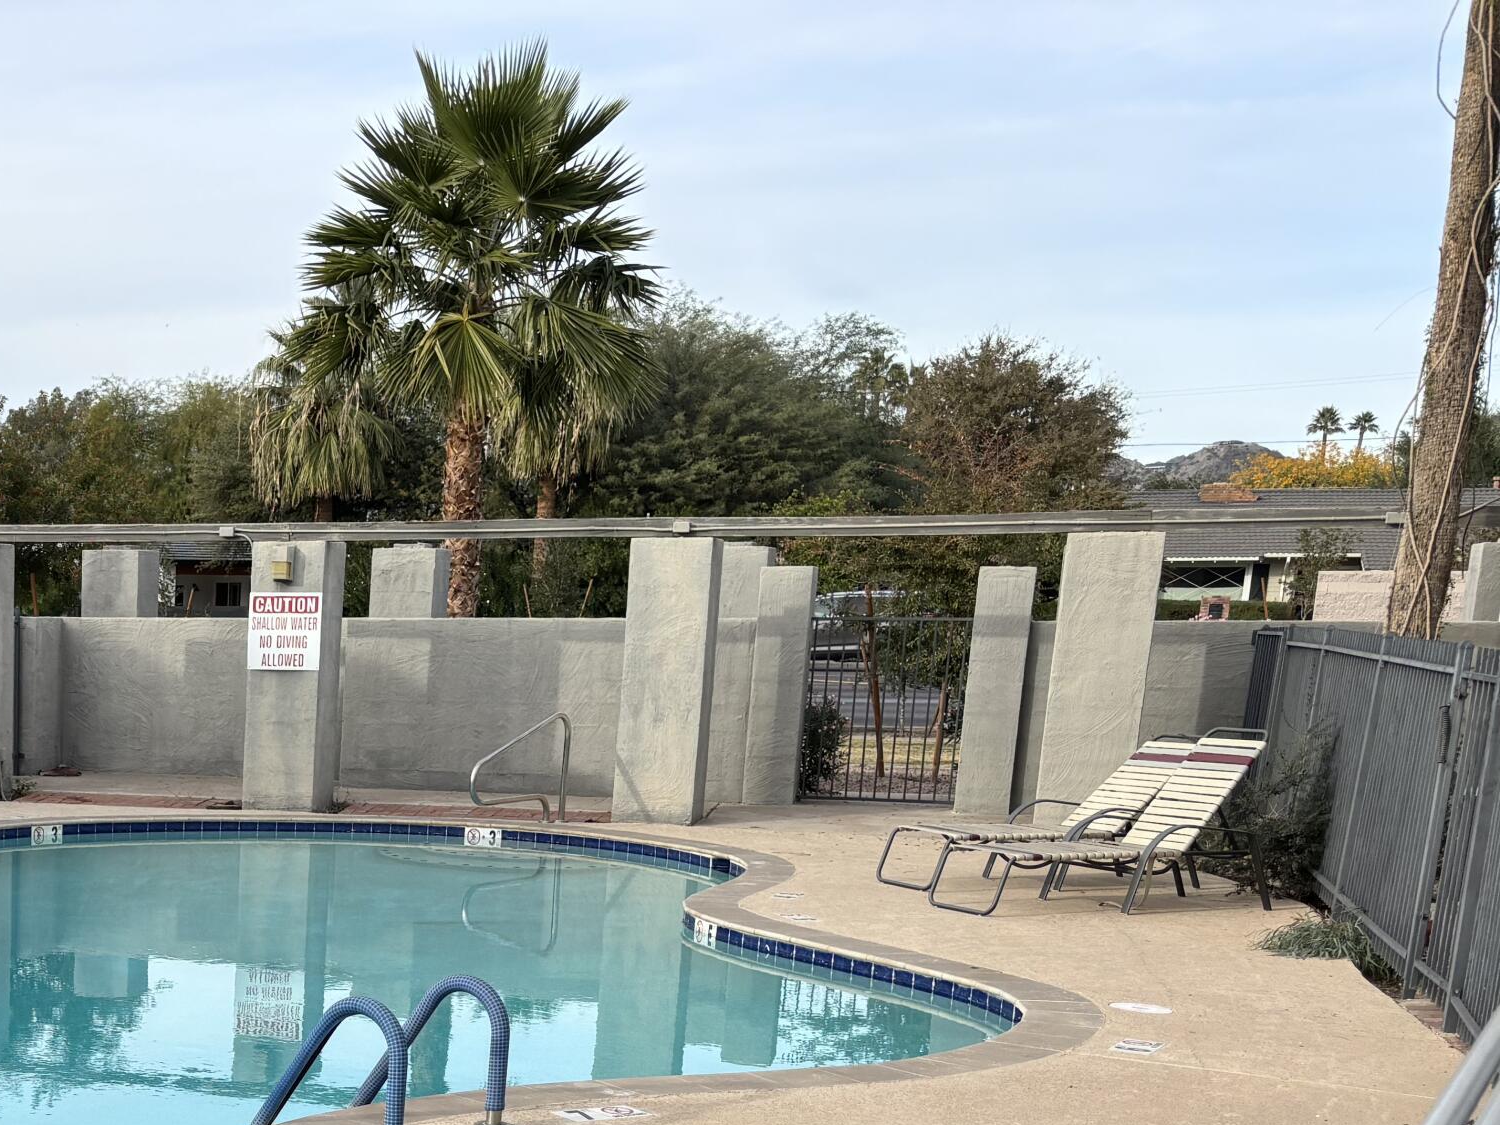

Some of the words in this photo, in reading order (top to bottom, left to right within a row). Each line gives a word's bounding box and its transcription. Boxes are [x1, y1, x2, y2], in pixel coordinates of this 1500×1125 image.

[255, 597, 316, 613] CAUTION
[251, 616, 288, 631] SHALLOW
[290, 616, 318, 631] WATER
[259, 635, 272, 649] NO
[276, 635, 308, 649] DIVING
[261, 653, 304, 668] ALLOWED
